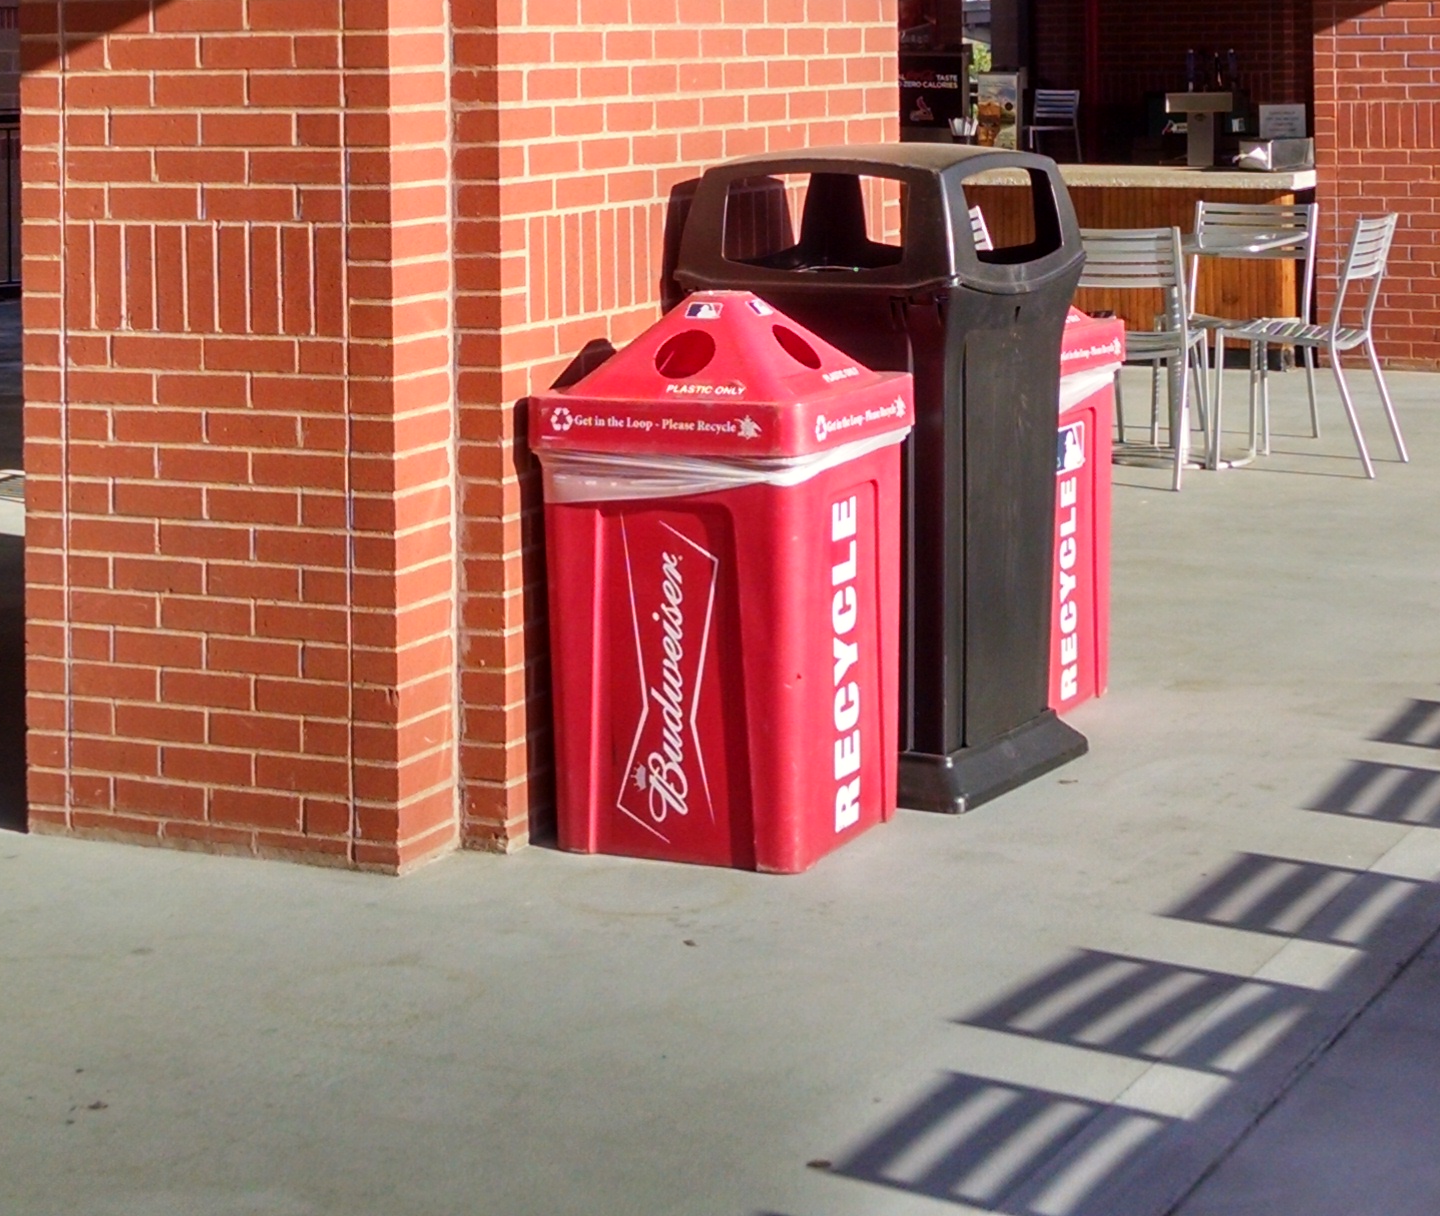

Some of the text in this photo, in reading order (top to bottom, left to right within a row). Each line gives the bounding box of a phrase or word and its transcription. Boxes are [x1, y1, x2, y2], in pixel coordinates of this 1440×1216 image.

[574, 414, 593, 427] Get
[594, 415, 606, 427] in
[607, 416, 625, 428] the
[626, 416, 653, 431] Loop
[662, 418, 695, 431] Please
[696, 420, 737, 435] Recycle
[665, 384, 747, 396] PLASTIC ONLY
[648, 551, 688, 822] Budweiser
[831, 494, 860, 833] RECYCLE
[1060, 476, 1078, 701] RECYCLE
